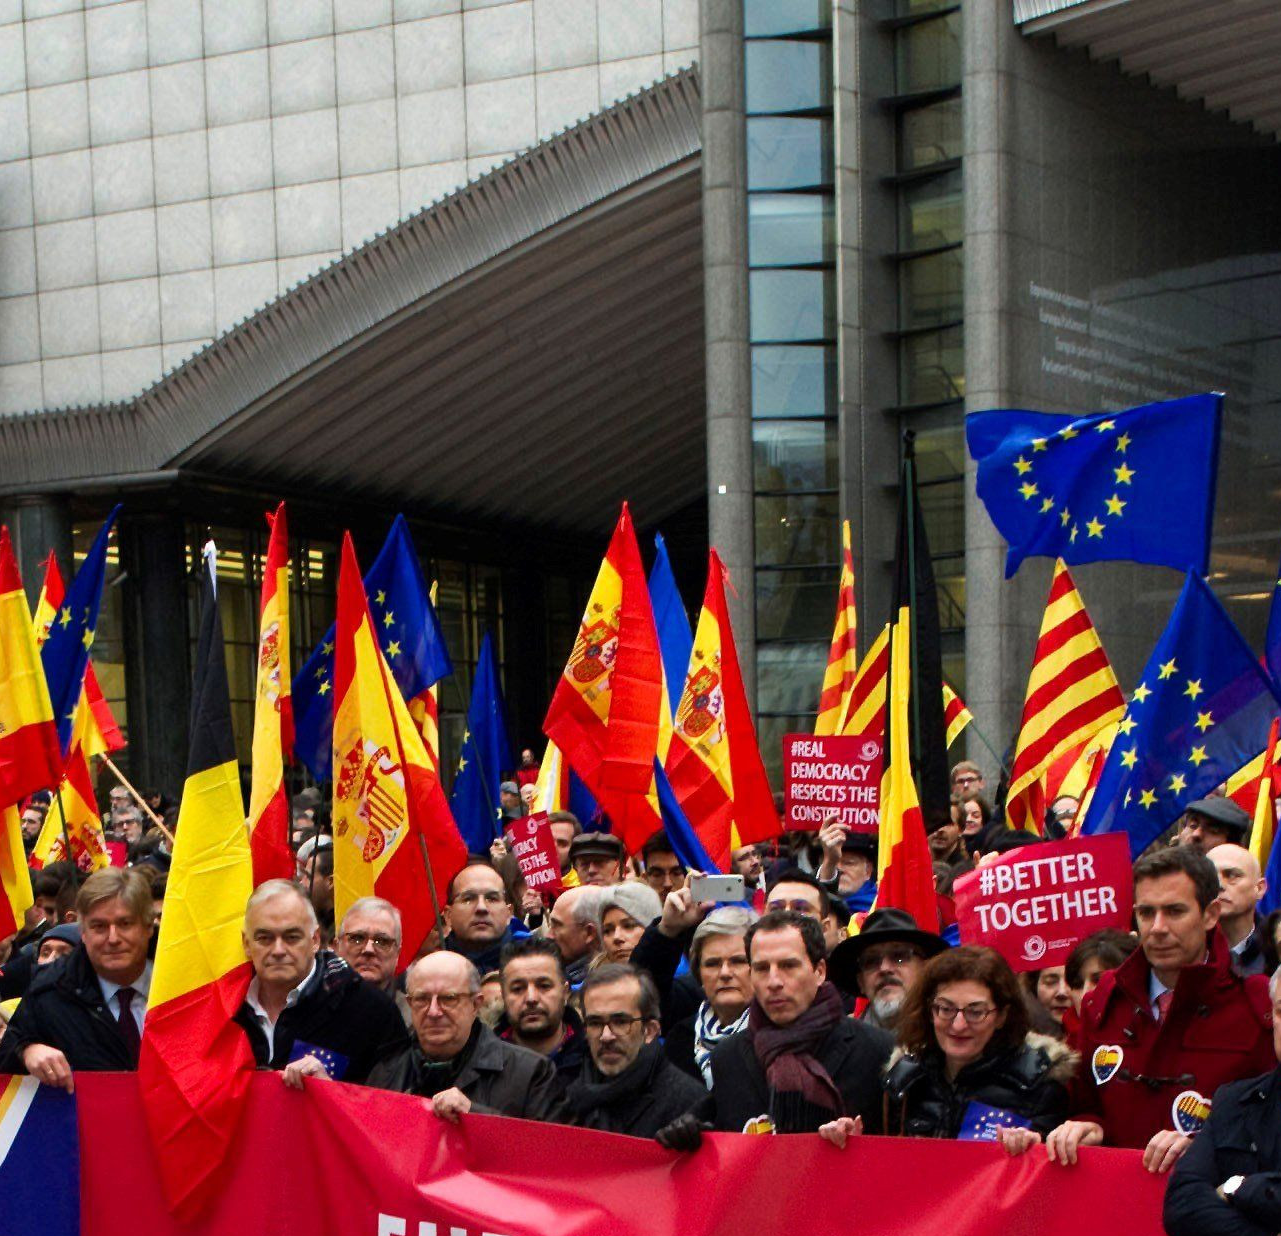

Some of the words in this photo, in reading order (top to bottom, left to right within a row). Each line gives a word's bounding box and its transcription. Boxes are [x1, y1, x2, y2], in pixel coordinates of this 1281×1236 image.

[791, 741, 826, 758] #REAL
[791, 762, 871, 781] DEMOCRACY
[791, 783, 847, 802] RESPECTS
[848, 786, 878, 803] THE
[979, 852, 1096, 896] #BETTER
[973, 886, 1118, 933] TOGETHER
